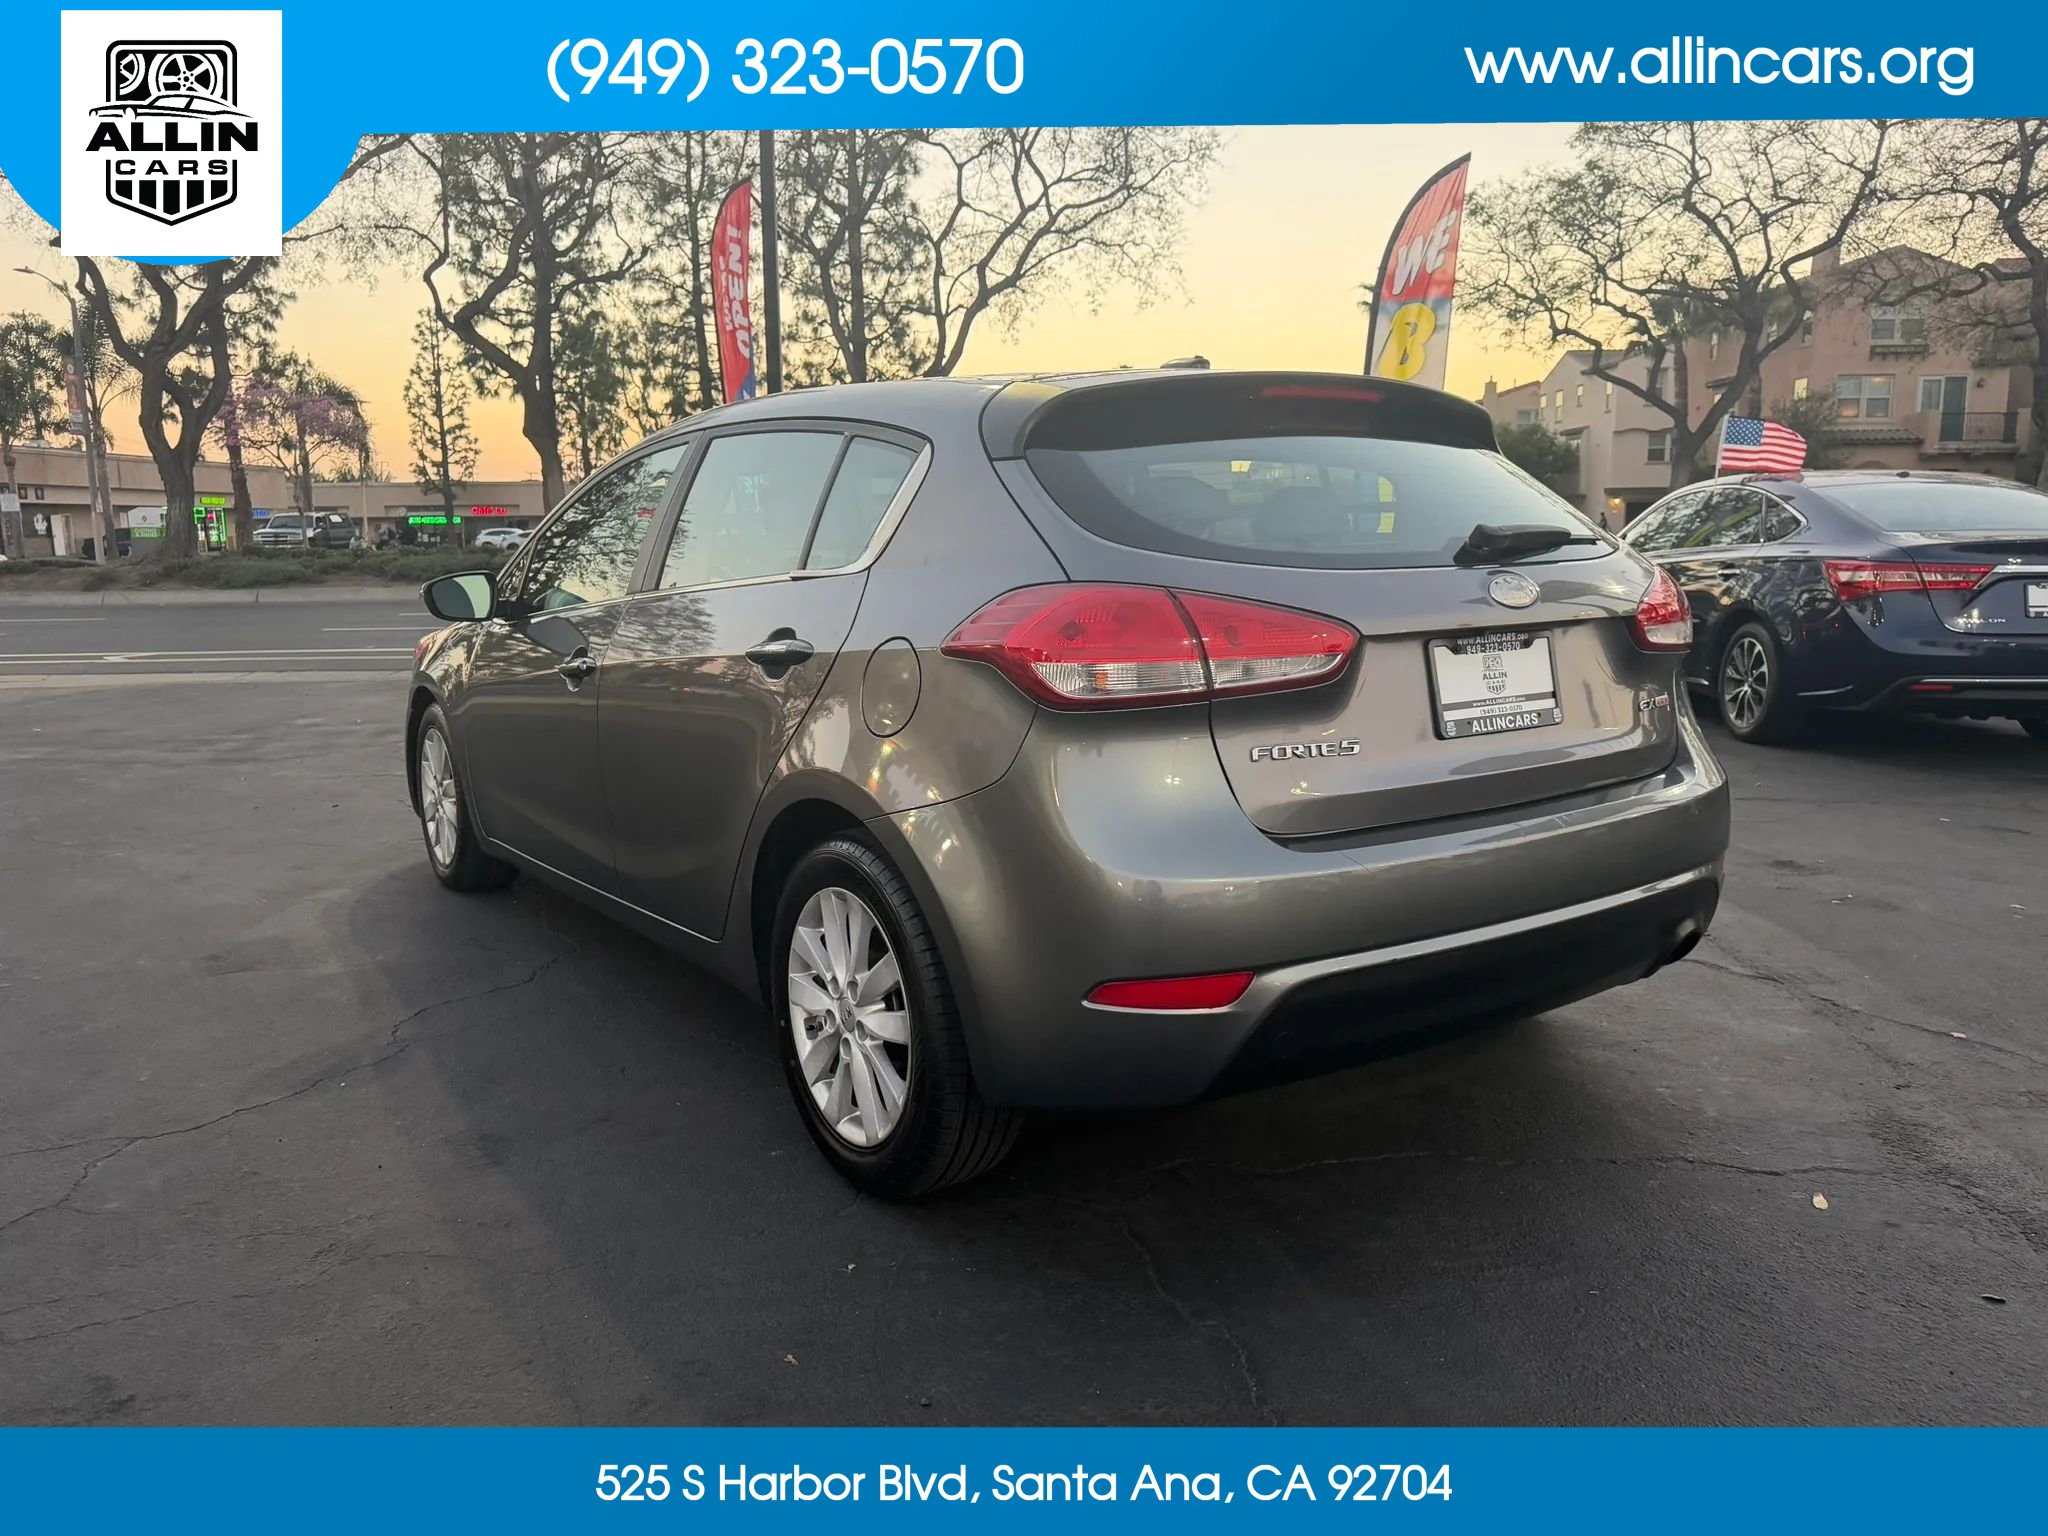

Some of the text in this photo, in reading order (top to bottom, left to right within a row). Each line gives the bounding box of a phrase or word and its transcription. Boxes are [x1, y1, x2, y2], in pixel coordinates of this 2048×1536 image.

[1391, 208, 1457, 296] WE
[1466, 641, 1521, 655] 949-323-0570
[1482, 671, 1508, 681] ALLIN
[1471, 712, 1539, 734] ALLINCARS
